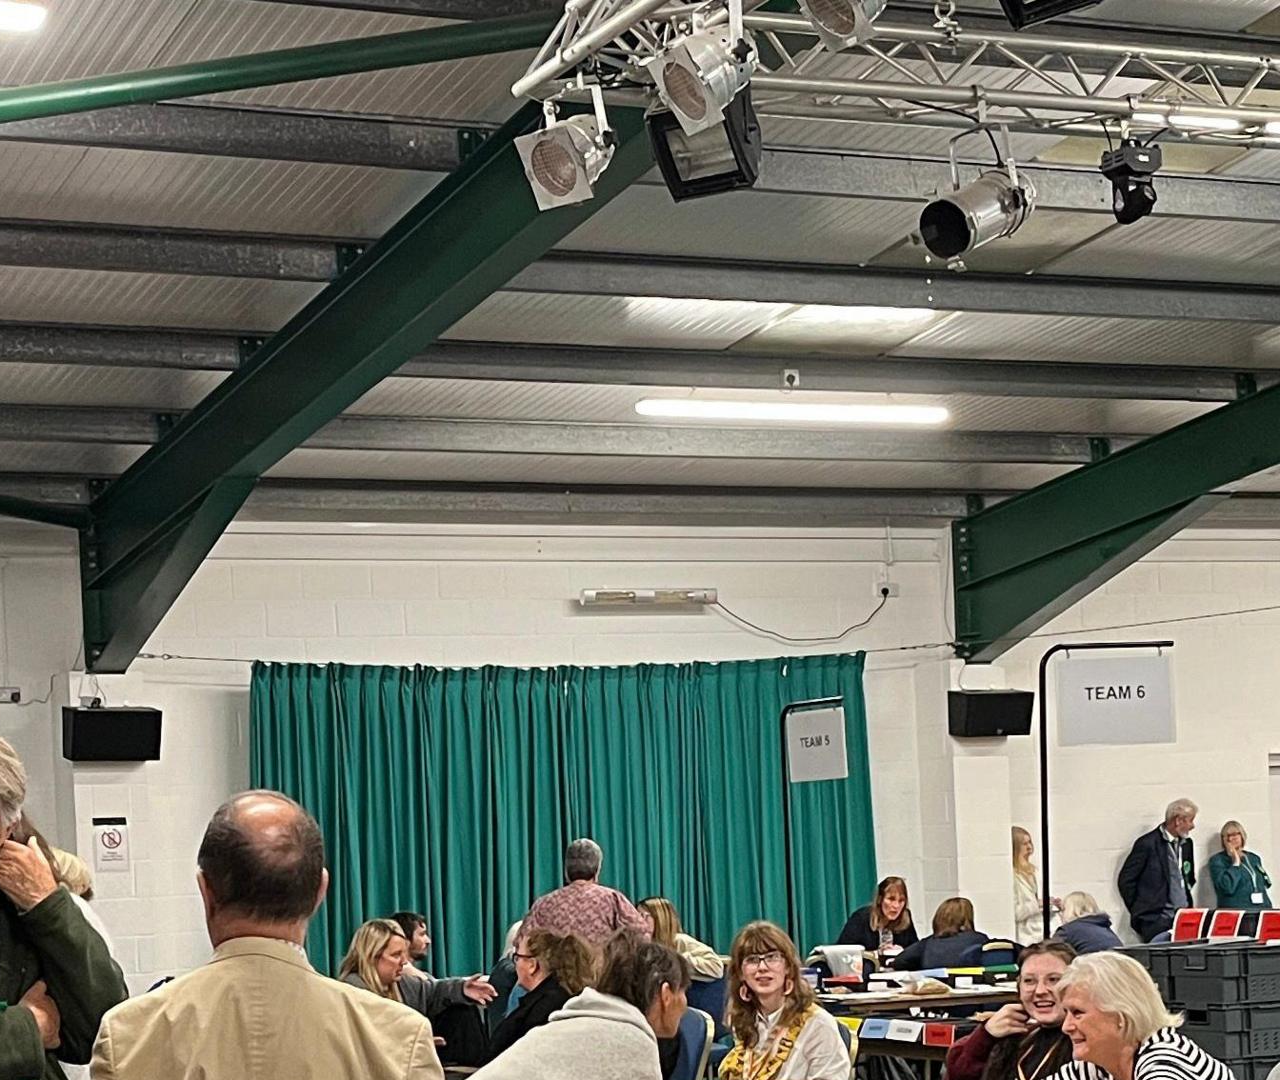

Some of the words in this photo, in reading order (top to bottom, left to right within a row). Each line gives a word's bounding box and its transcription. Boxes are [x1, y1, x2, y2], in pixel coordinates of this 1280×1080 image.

[1084, 685, 1131, 701] TEAM
[1136, 685, 1146, 699] 6
[799, 735, 823, 749] TEAM
[824, 734, 831, 746] 5
